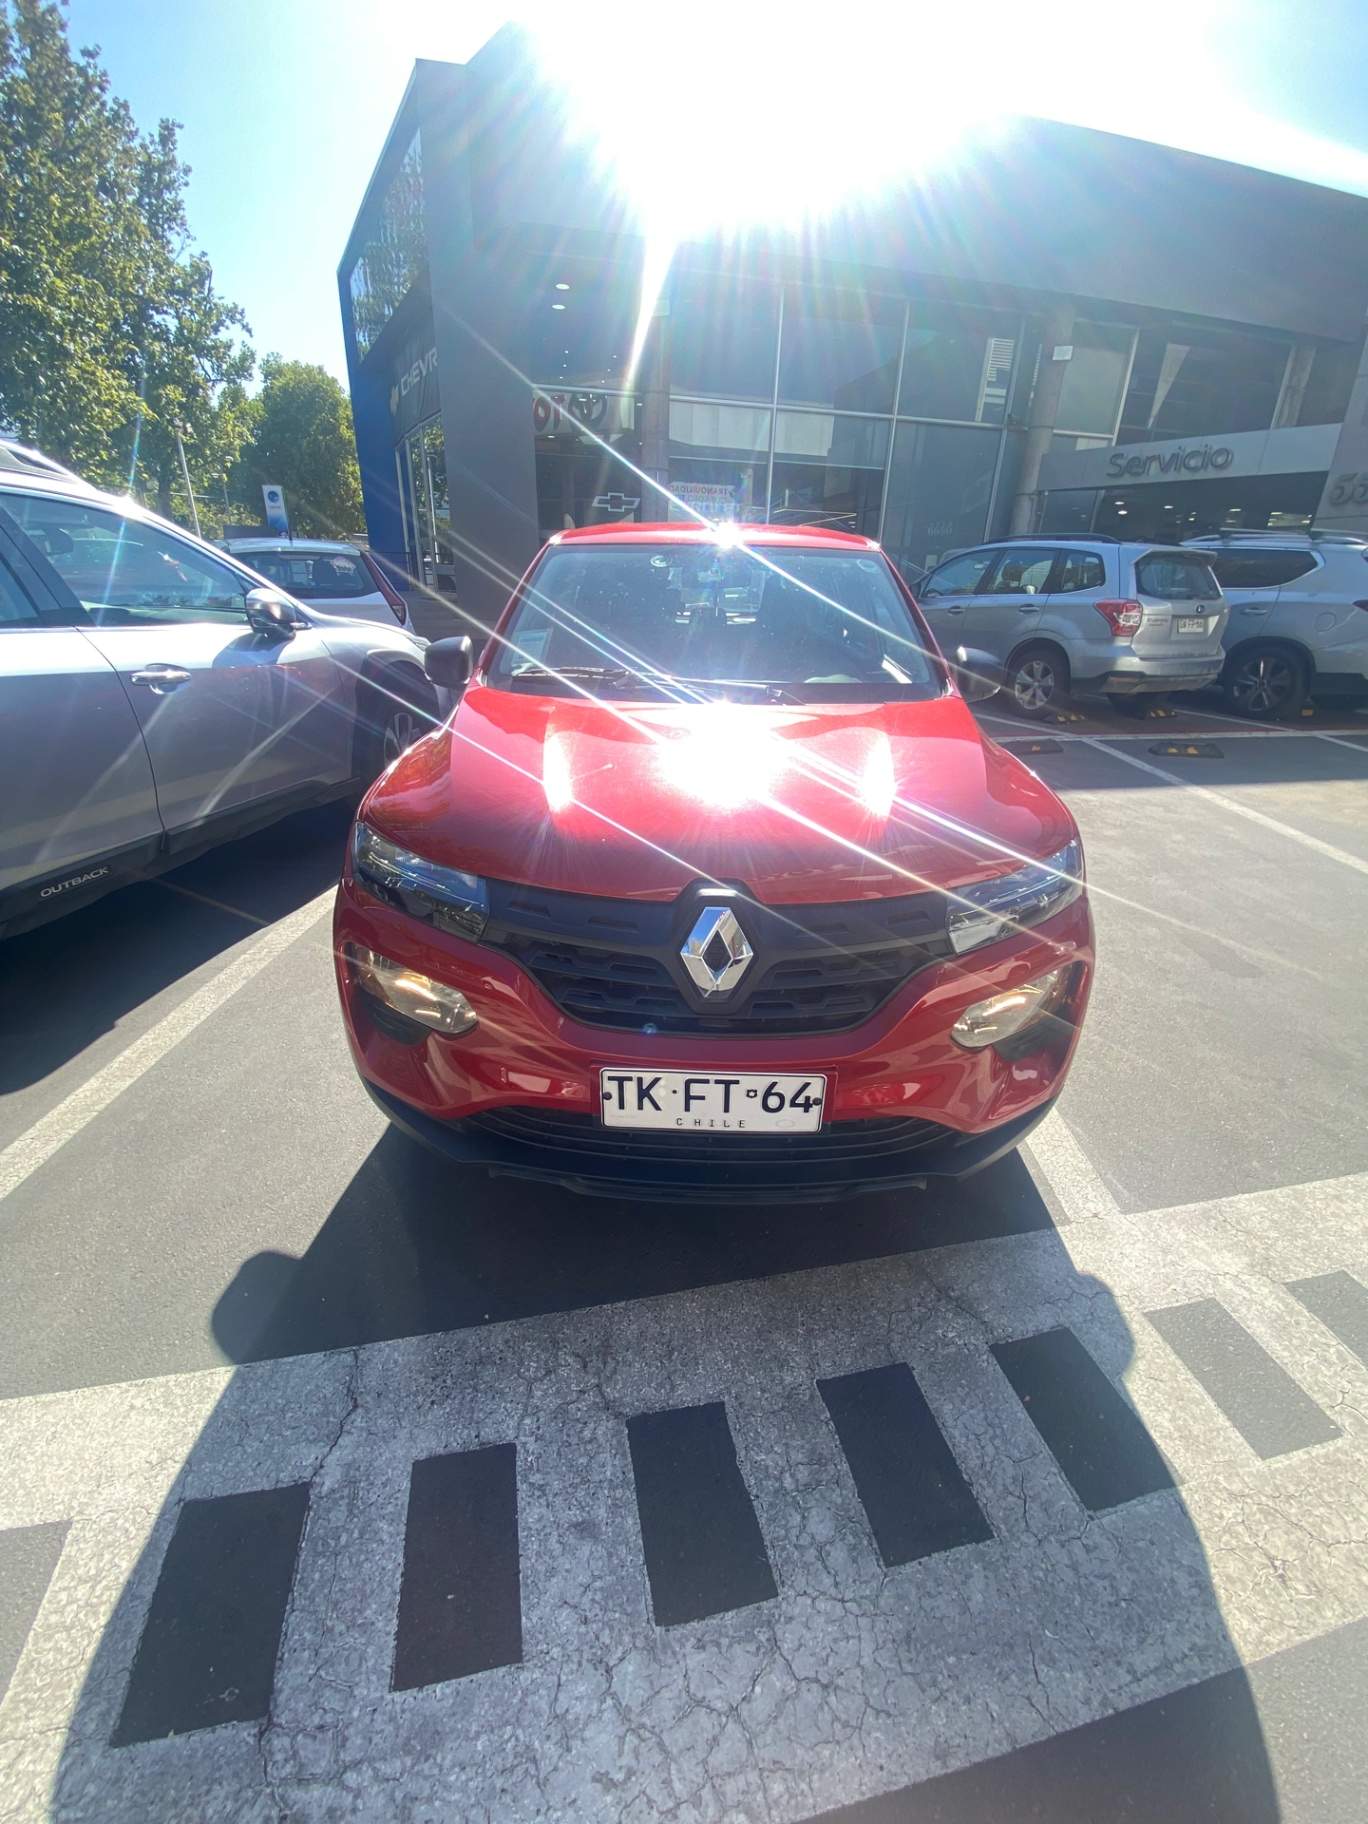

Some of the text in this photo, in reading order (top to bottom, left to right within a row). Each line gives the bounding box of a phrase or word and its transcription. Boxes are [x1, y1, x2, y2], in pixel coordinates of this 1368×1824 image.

[1106, 444, 1233, 478] Servicio
[40, 867, 109, 897] OUTBACK
[607, 1075, 814, 1114] TK FT 64
[675, 1117, 746, 1129] CHILE
